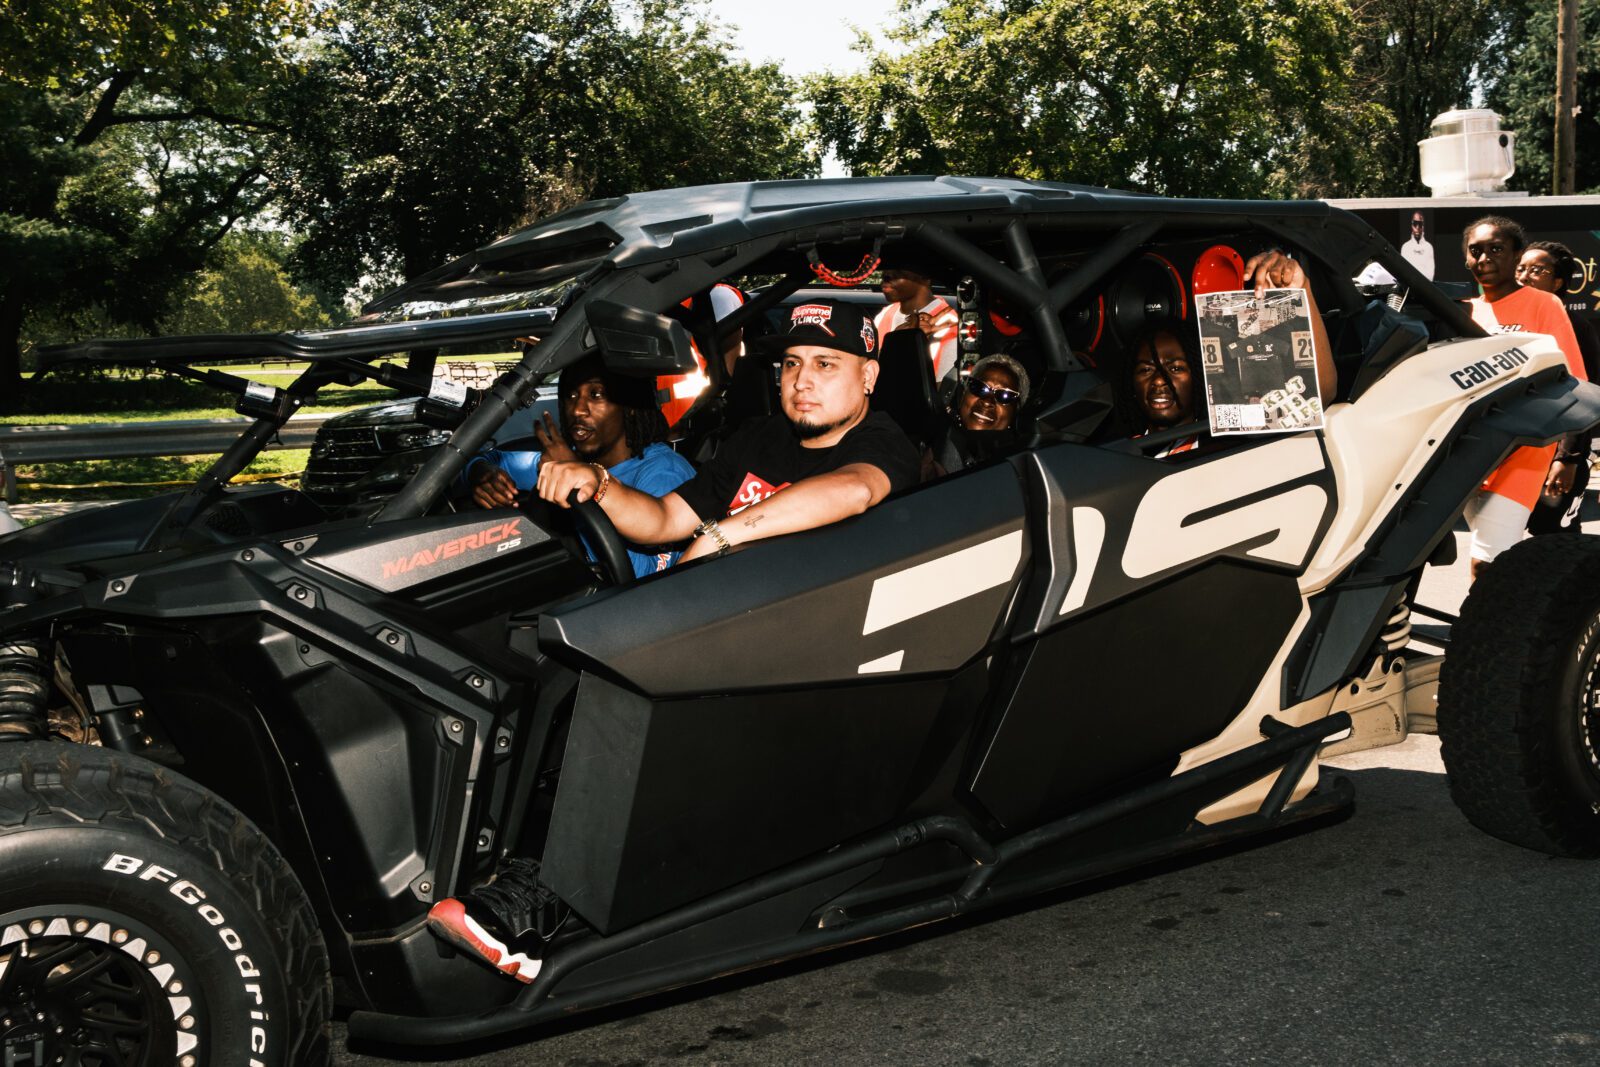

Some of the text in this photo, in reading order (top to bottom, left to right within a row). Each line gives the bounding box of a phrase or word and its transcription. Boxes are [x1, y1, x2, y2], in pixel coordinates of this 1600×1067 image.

[793, 307, 830, 318] Supreme
[1450, 347, 1529, 390] can-am
[1280, 401, 1320, 429] LIFE
[382, 519, 522, 579] MAVERICK
[496, 537, 522, 552] DS
